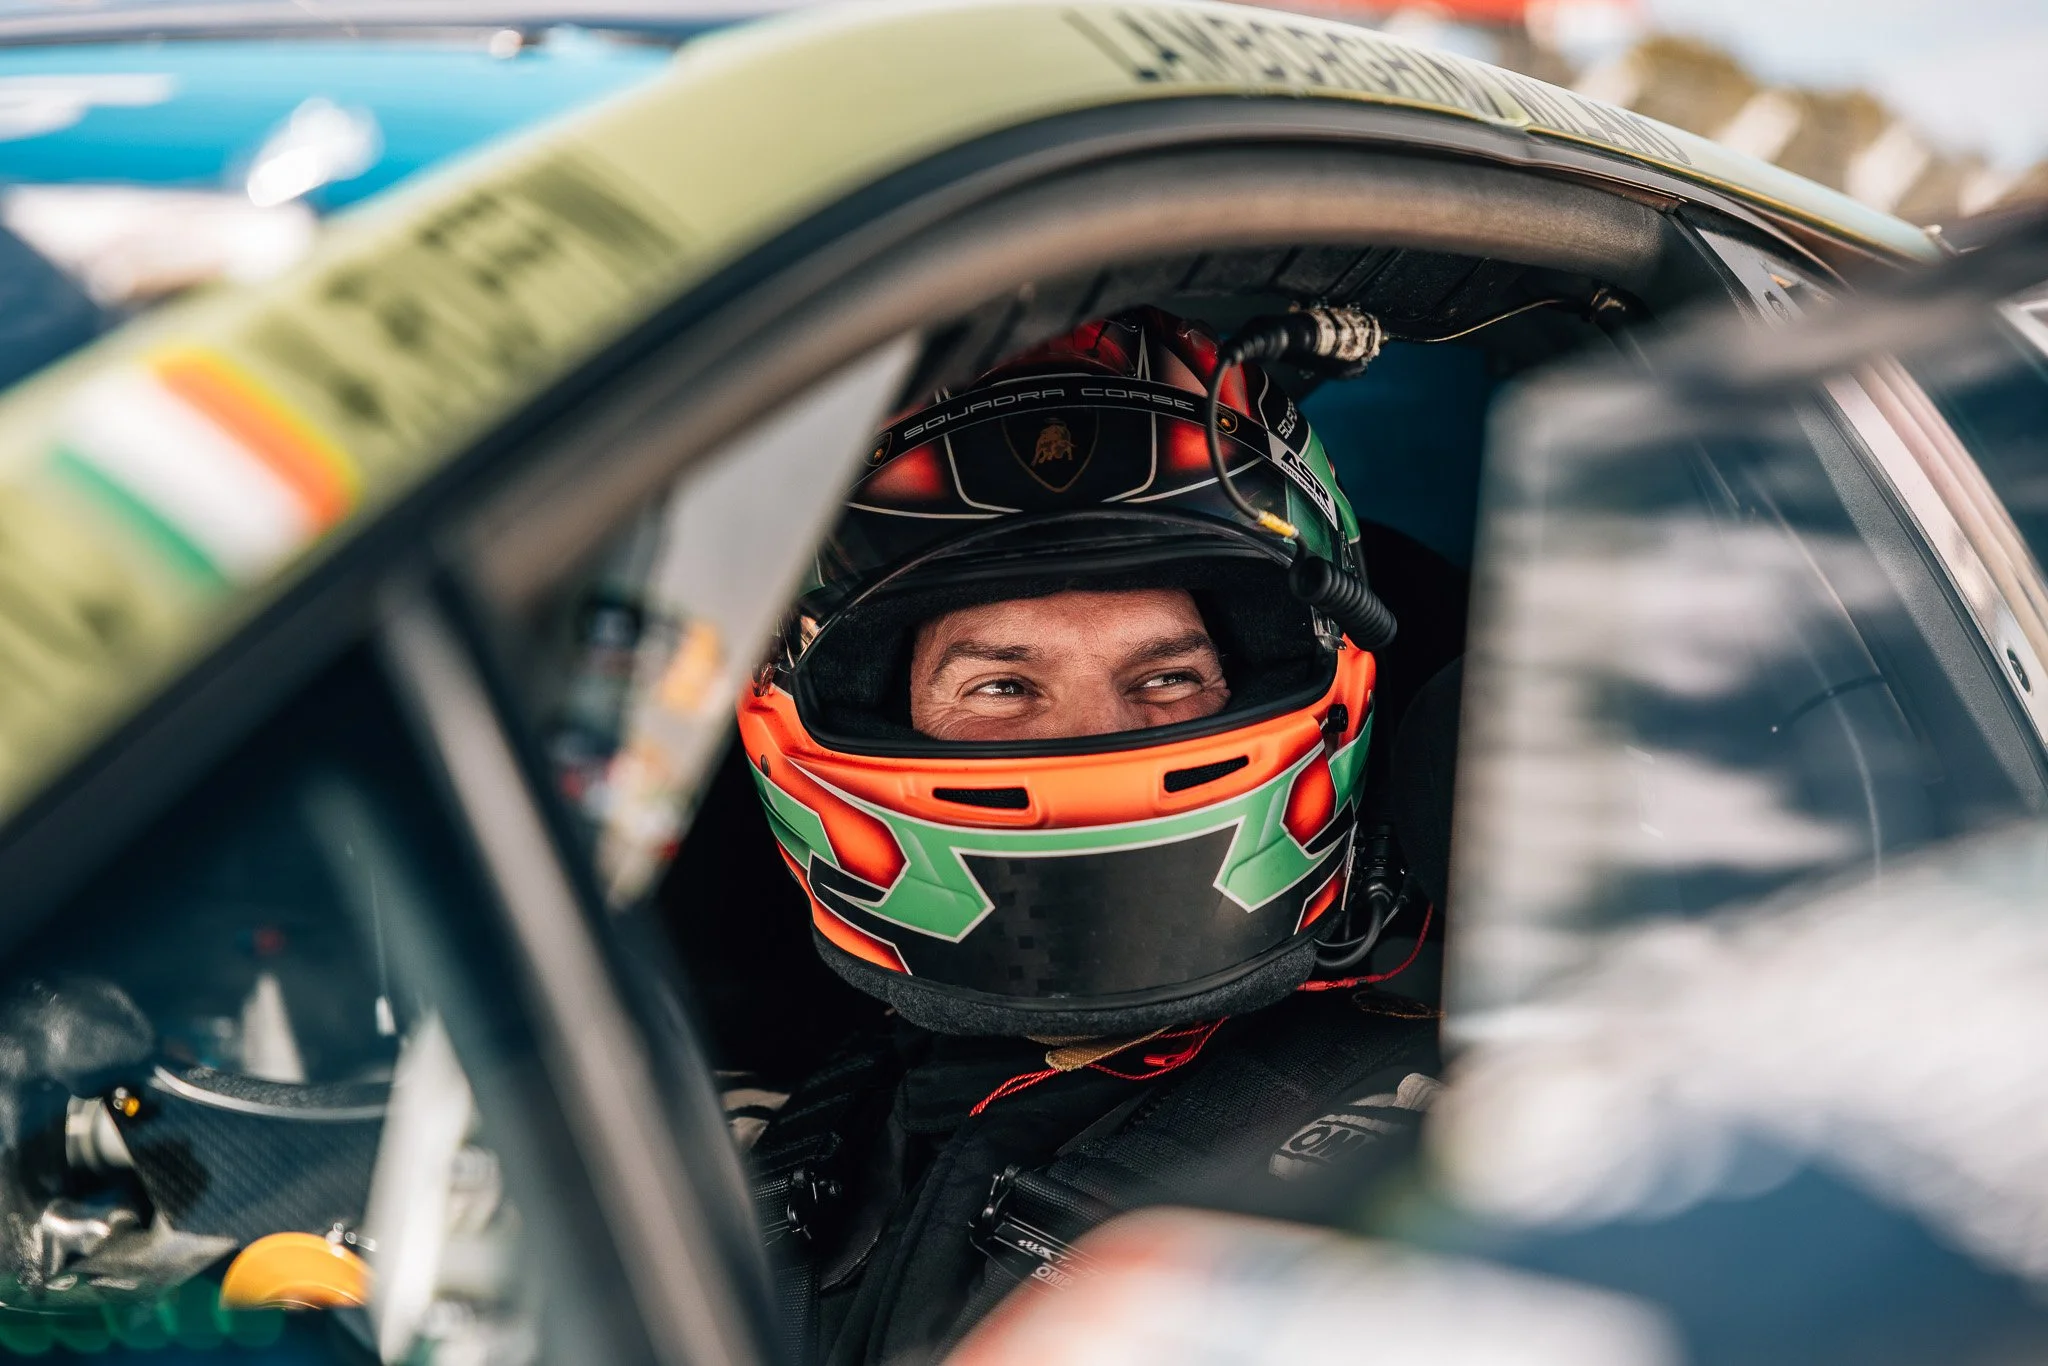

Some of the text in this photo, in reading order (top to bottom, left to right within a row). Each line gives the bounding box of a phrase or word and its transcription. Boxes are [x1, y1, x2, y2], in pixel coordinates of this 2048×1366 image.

[1500, 72, 1692, 166] MILANO
[903, 387, 1195, 441] SQUADRA CORSE
[1281, 450, 1330, 511] ASR
